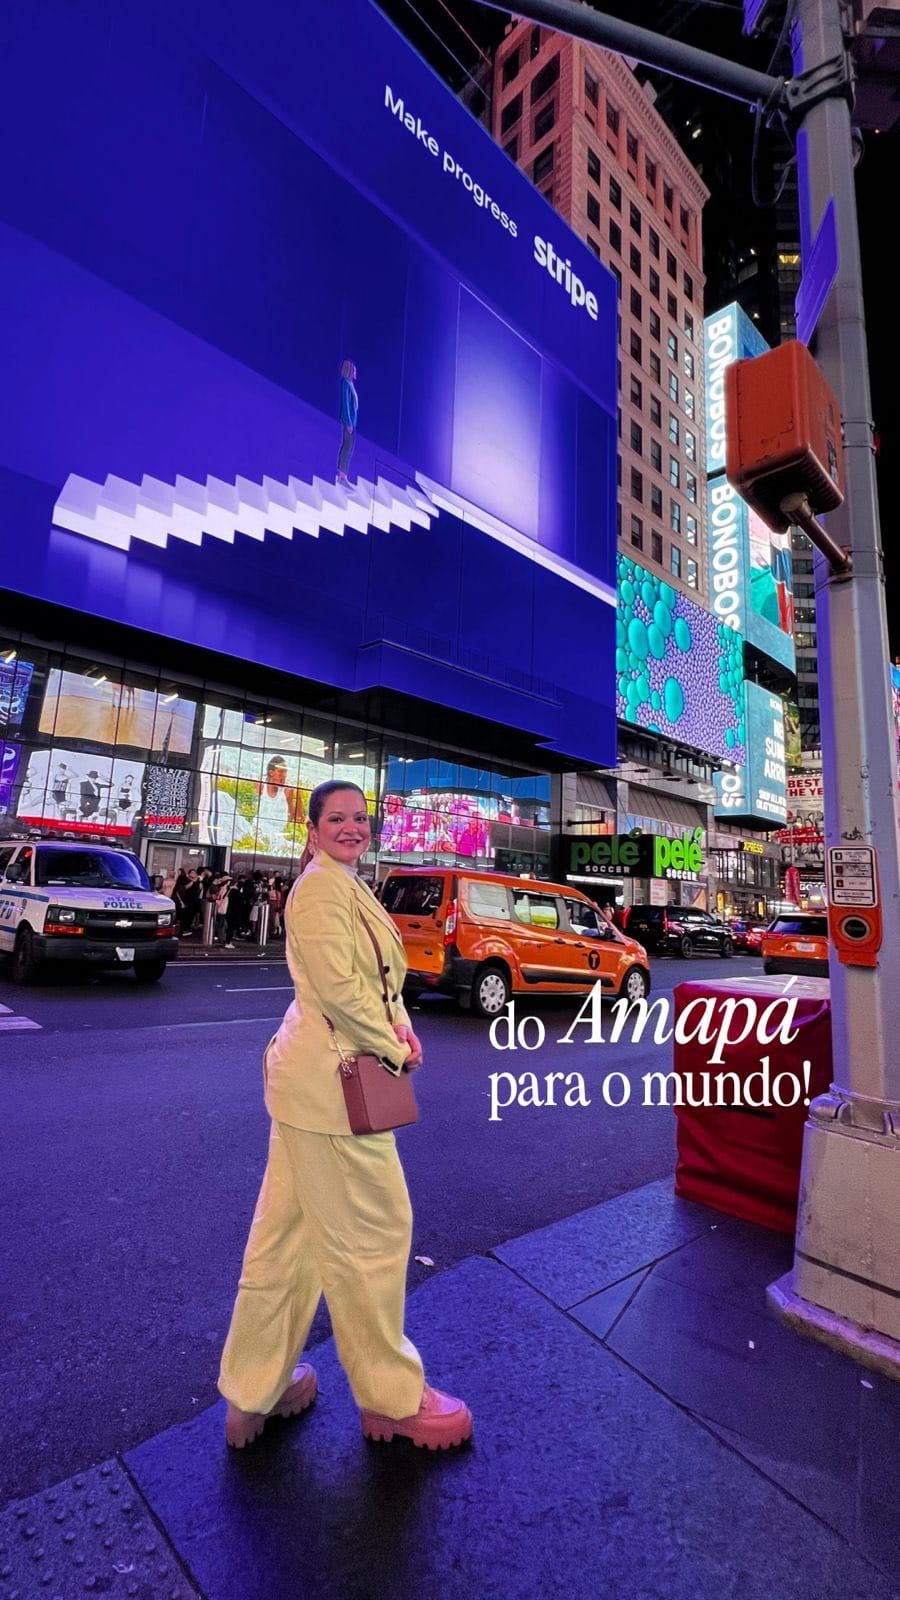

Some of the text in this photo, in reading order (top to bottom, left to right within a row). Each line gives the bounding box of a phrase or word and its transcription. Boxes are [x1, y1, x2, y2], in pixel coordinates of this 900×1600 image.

[385, 85, 518, 238] Make progress
[534, 235, 599, 321] stripe
[787, 779, 820, 788] BEST
[786, 788, 806, 797] HE
[585, 865, 631, 874] SOCCER
[666, 868, 697, 881] SOCCER
[103, 901, 143, 910] POLICE
